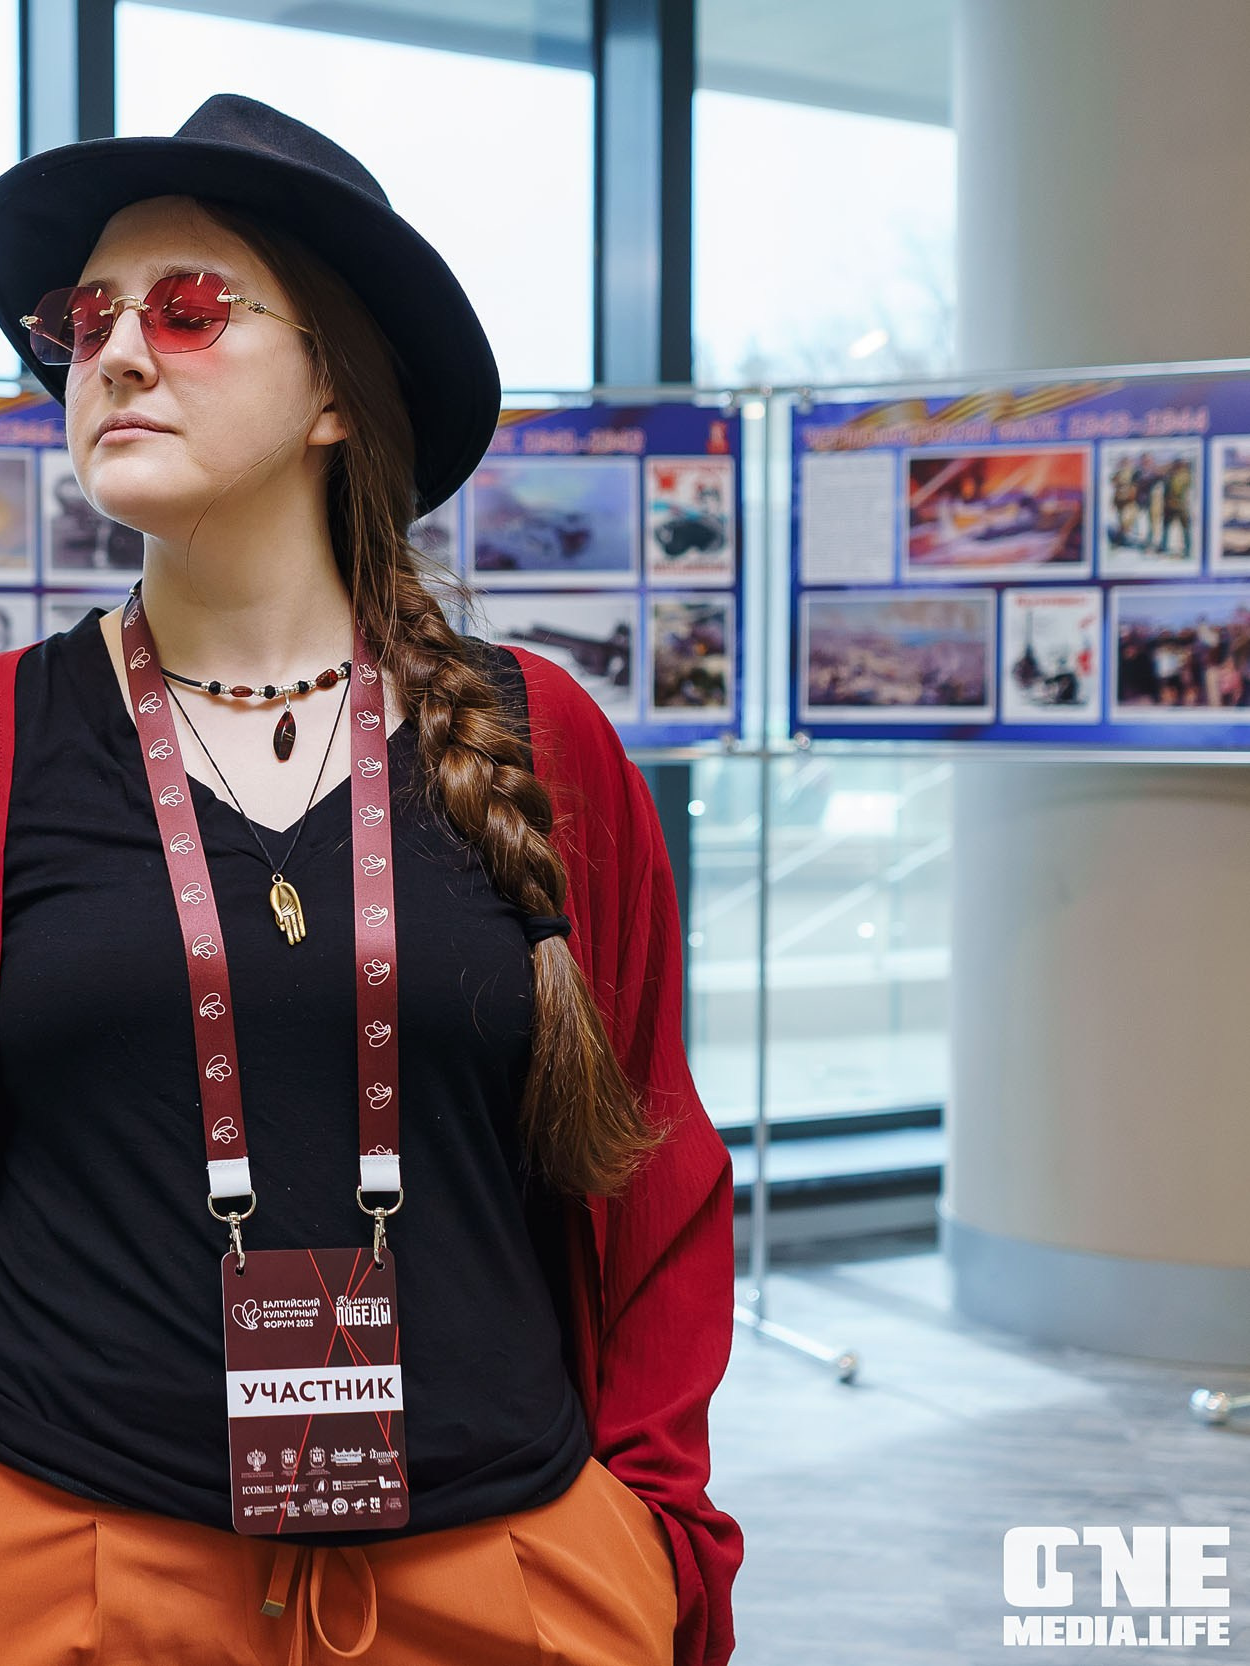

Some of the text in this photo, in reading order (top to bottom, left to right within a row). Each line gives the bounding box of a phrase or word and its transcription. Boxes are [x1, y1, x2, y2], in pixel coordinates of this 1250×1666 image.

[263, 1298, 321, 1309] БАЛТИЙСКИЙ
[335, 1295, 390, 1310] Культура
[263, 1308, 319, 1319] КУЛЬТУРНЫЙ
[336, 1305, 391, 1327] ПОБЕДЫ
[263, 1319, 314, 1329] ФОРУМ 2025
[240, 1377, 395, 1405] УЧАСТНИК
